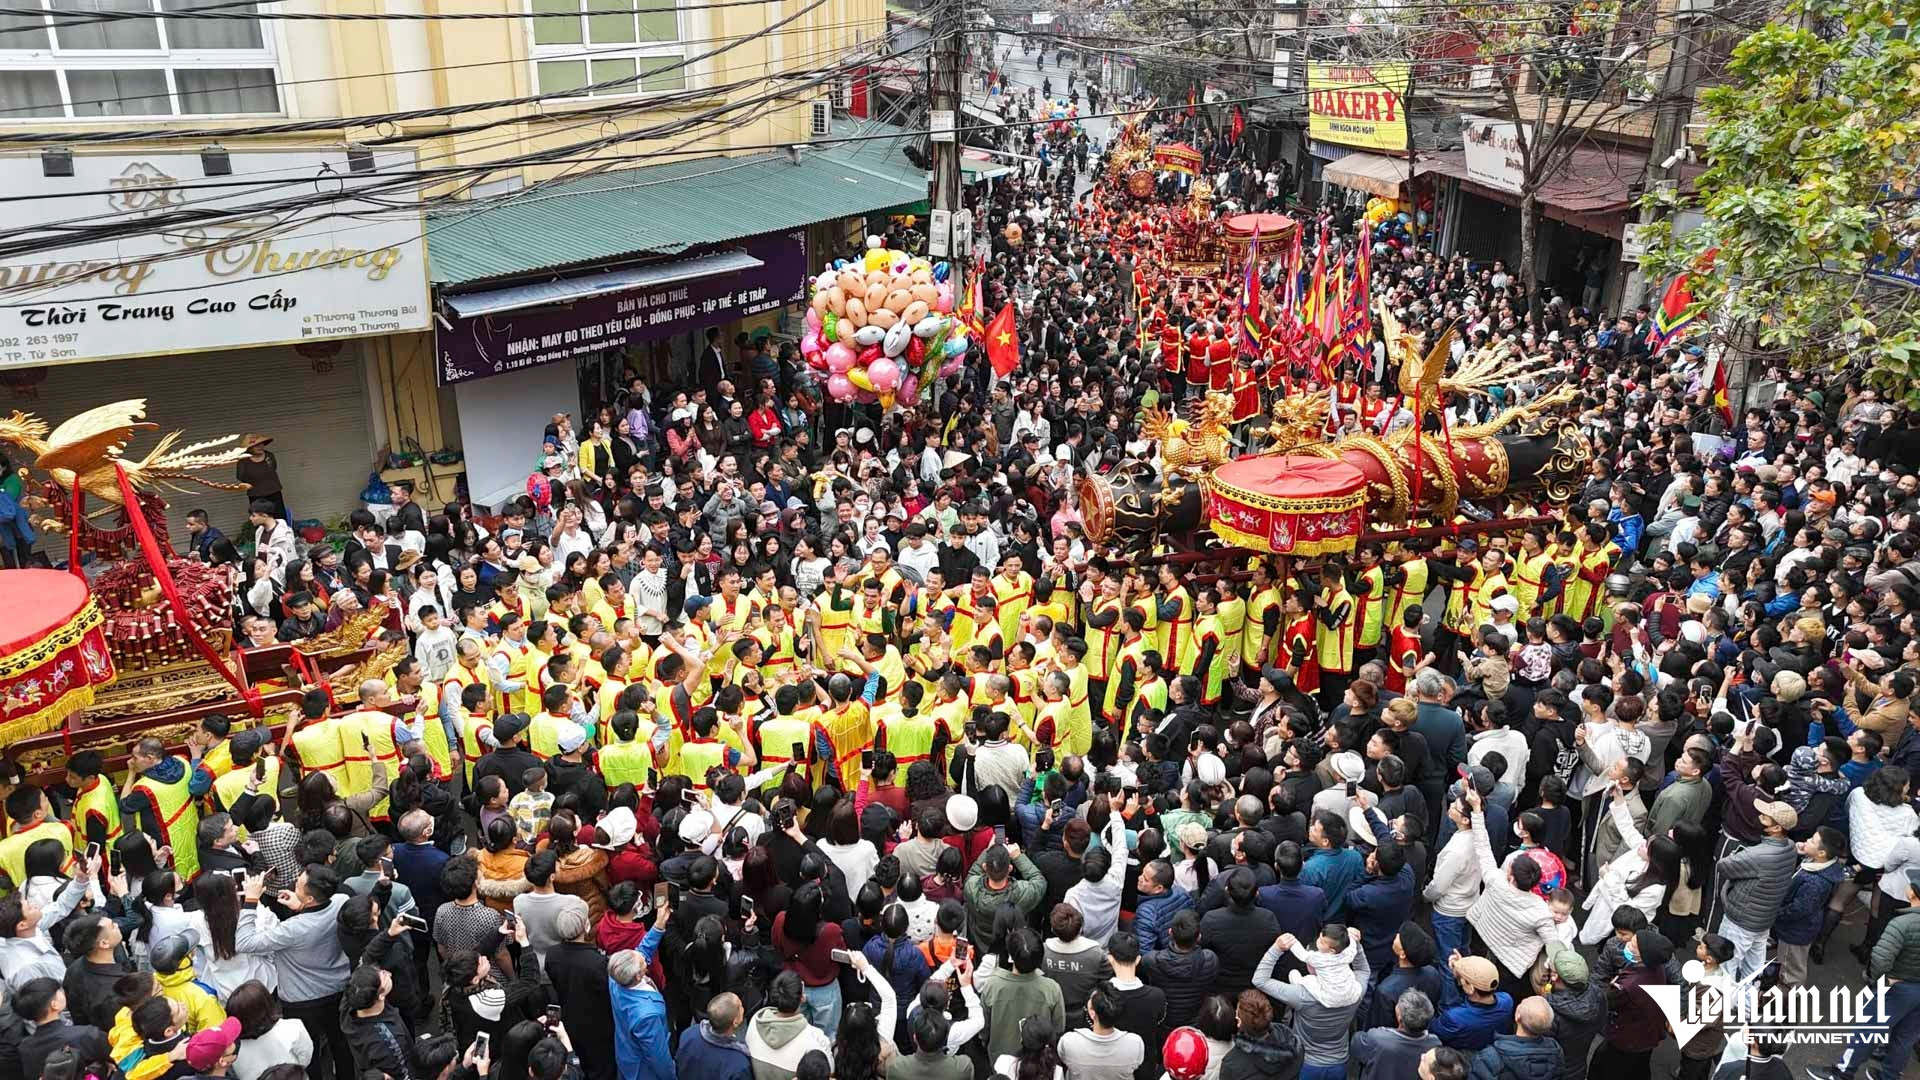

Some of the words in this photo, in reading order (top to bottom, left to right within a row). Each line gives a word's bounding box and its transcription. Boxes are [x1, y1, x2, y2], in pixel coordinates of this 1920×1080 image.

[1313, 88, 1401, 121] BAKERY
[20, 306, 87, 327] Thời
[97, 303, 175, 322] Trang
[186, 298, 236, 315] Cao
[248, 289, 297, 312] Cấp
[650, 293, 666, 307] CHO
[26, 335, 49, 345] 263
[52, 333, 79, 343] 1997
[506, 339, 539, 355] NHẬN:
[541, 332, 563, 348] MAY
[580, 324, 603, 340] THEO
[605, 319, 622, 335] YÊU
[5, 352, 26, 362] TP.
